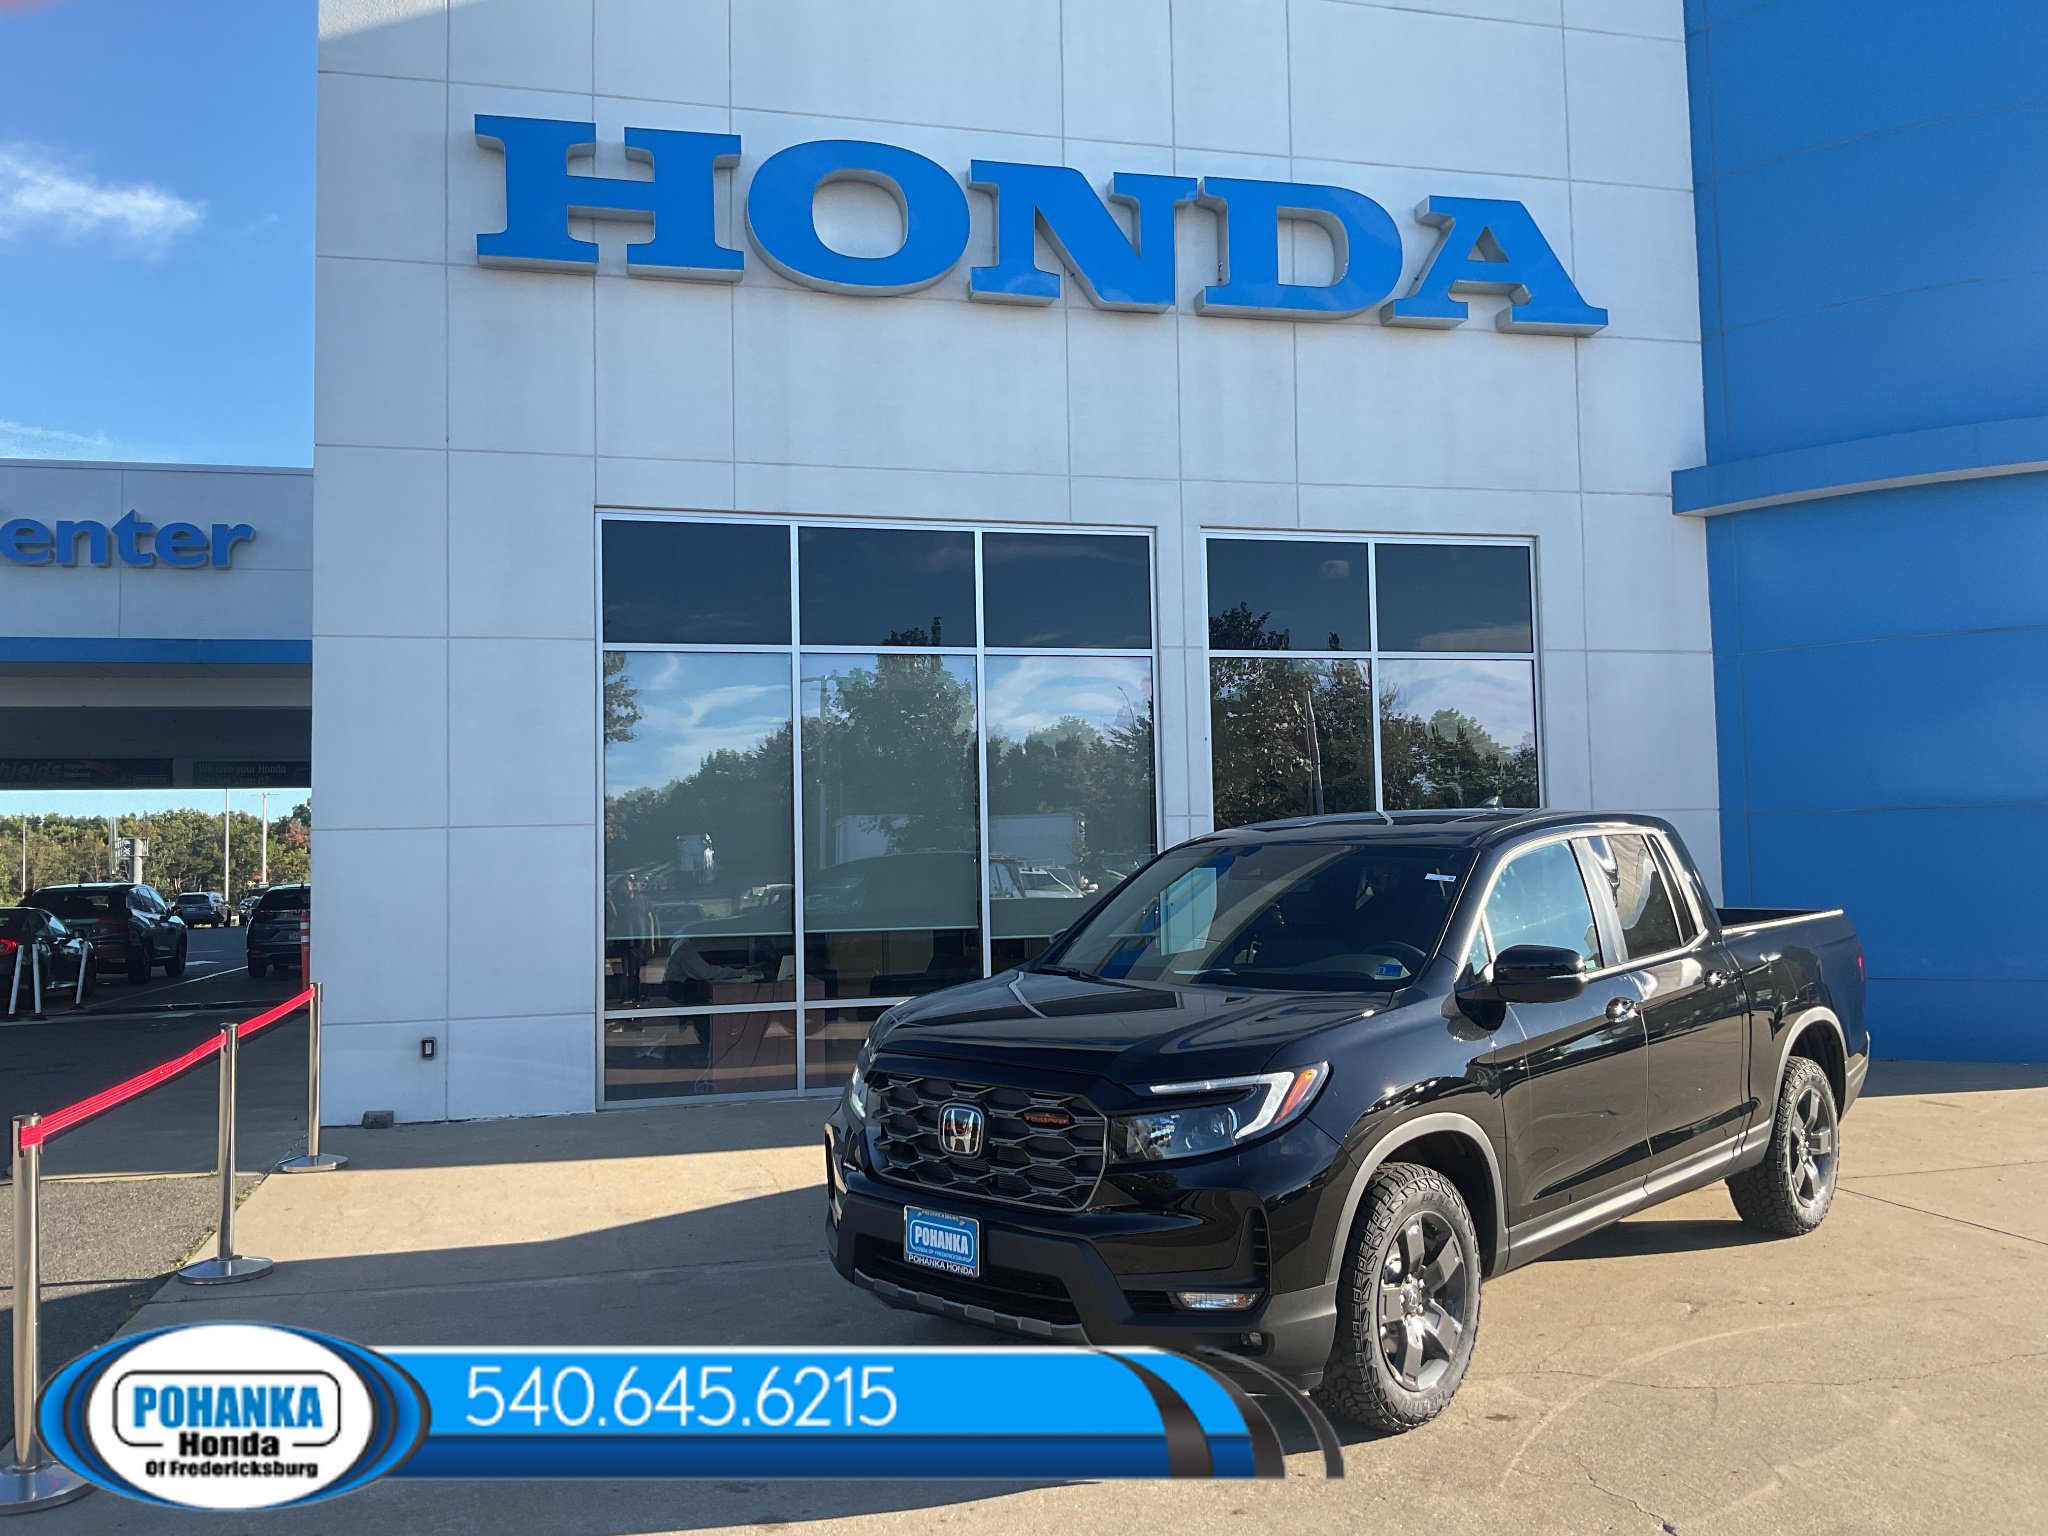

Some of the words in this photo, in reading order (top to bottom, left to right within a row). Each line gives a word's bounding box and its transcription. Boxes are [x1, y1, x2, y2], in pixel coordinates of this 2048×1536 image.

[475, 114, 1608, 336] HONDA
[0, 509, 255, 569] enter
[235, 765, 255, 775] your
[258, 763, 286, 774] Honda
[914, 1225, 969, 1255] POHANKA
[908, 1254, 945, 1269] POHANKA
[946, 1262, 974, 1276] HONDA
